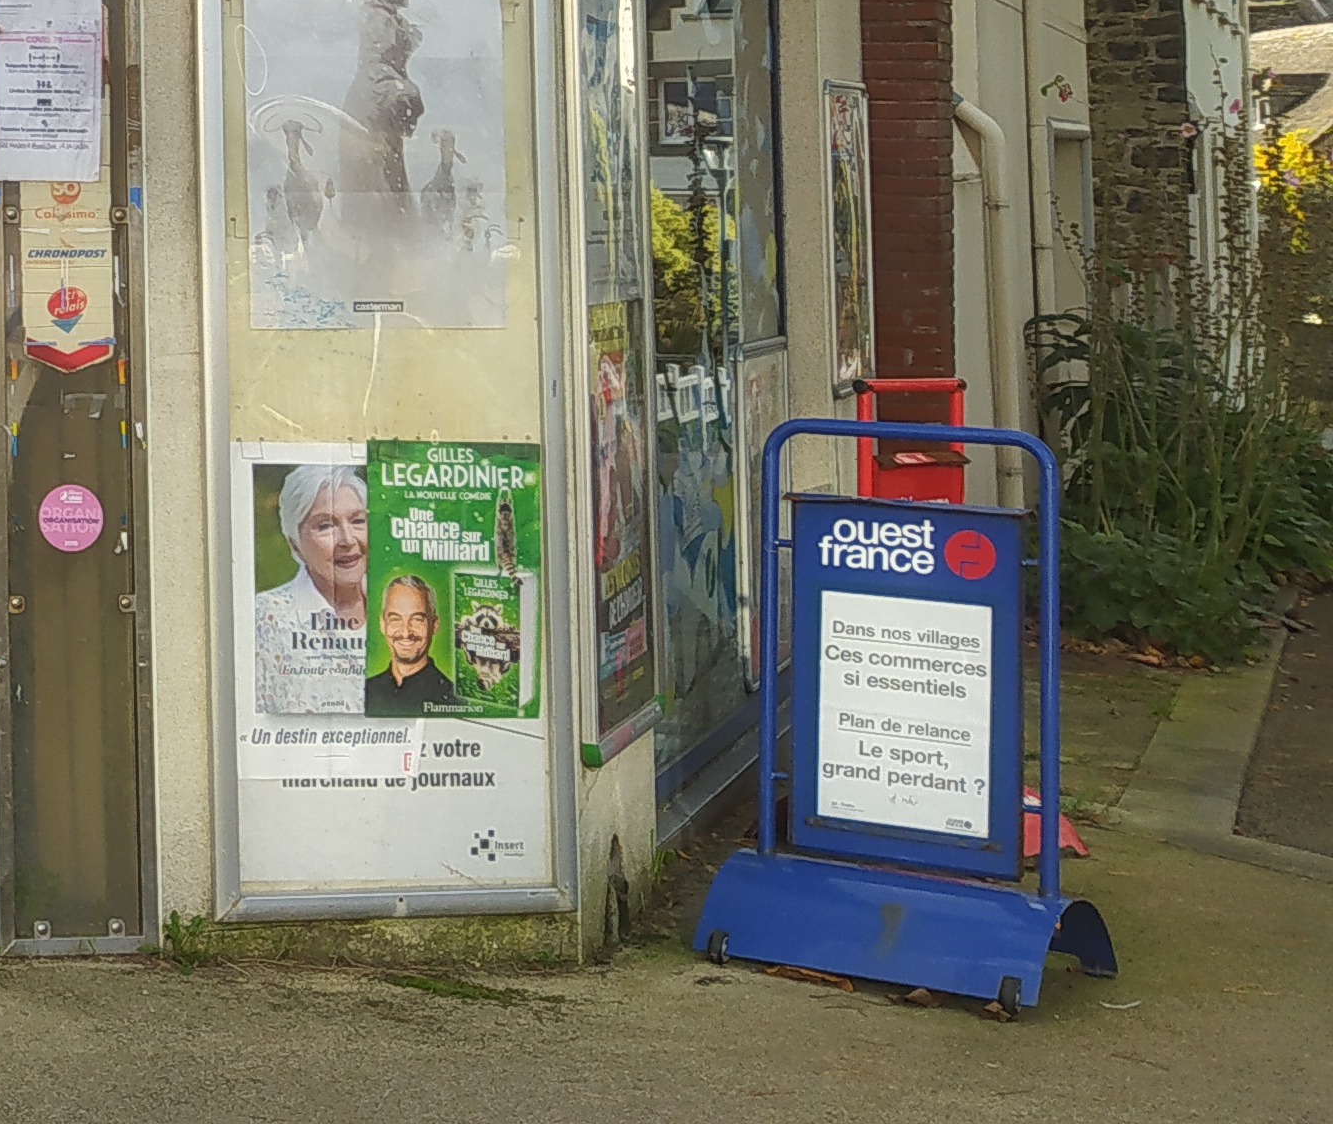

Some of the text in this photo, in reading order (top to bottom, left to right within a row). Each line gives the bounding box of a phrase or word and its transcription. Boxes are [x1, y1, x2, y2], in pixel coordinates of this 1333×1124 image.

[27, 249, 107, 259] CHRONOPOST
[355, 303, 402, 311] casterman
[427, 448, 474, 463] GILLES
[381, 463, 524, 489] LEGARDINIER
[416, 491, 457, 500] NOUVELLE
[409, 508, 433, 521] Une
[391, 518, 482, 543] Chance sur
[832, 518, 935, 550] ouest
[401, 539, 490, 562] un Milliard
[818, 539, 935, 575] france
[310, 613, 359, 631] Line
[832, 620, 981, 649] Dans nos villages
[825, 644, 988, 678] Ces commerces
[866, 673, 967, 699] essentiels
[423, 701, 484, 713] Flammarion
[275, 727, 317, 743] destin
[838, 712, 971, 742] Plan de relance
[433, 739, 481, 758] votre
[858, 741, 883, 758] Le
[822, 762, 968, 794] grand perdant
[494, 841, 524, 850] Insert
